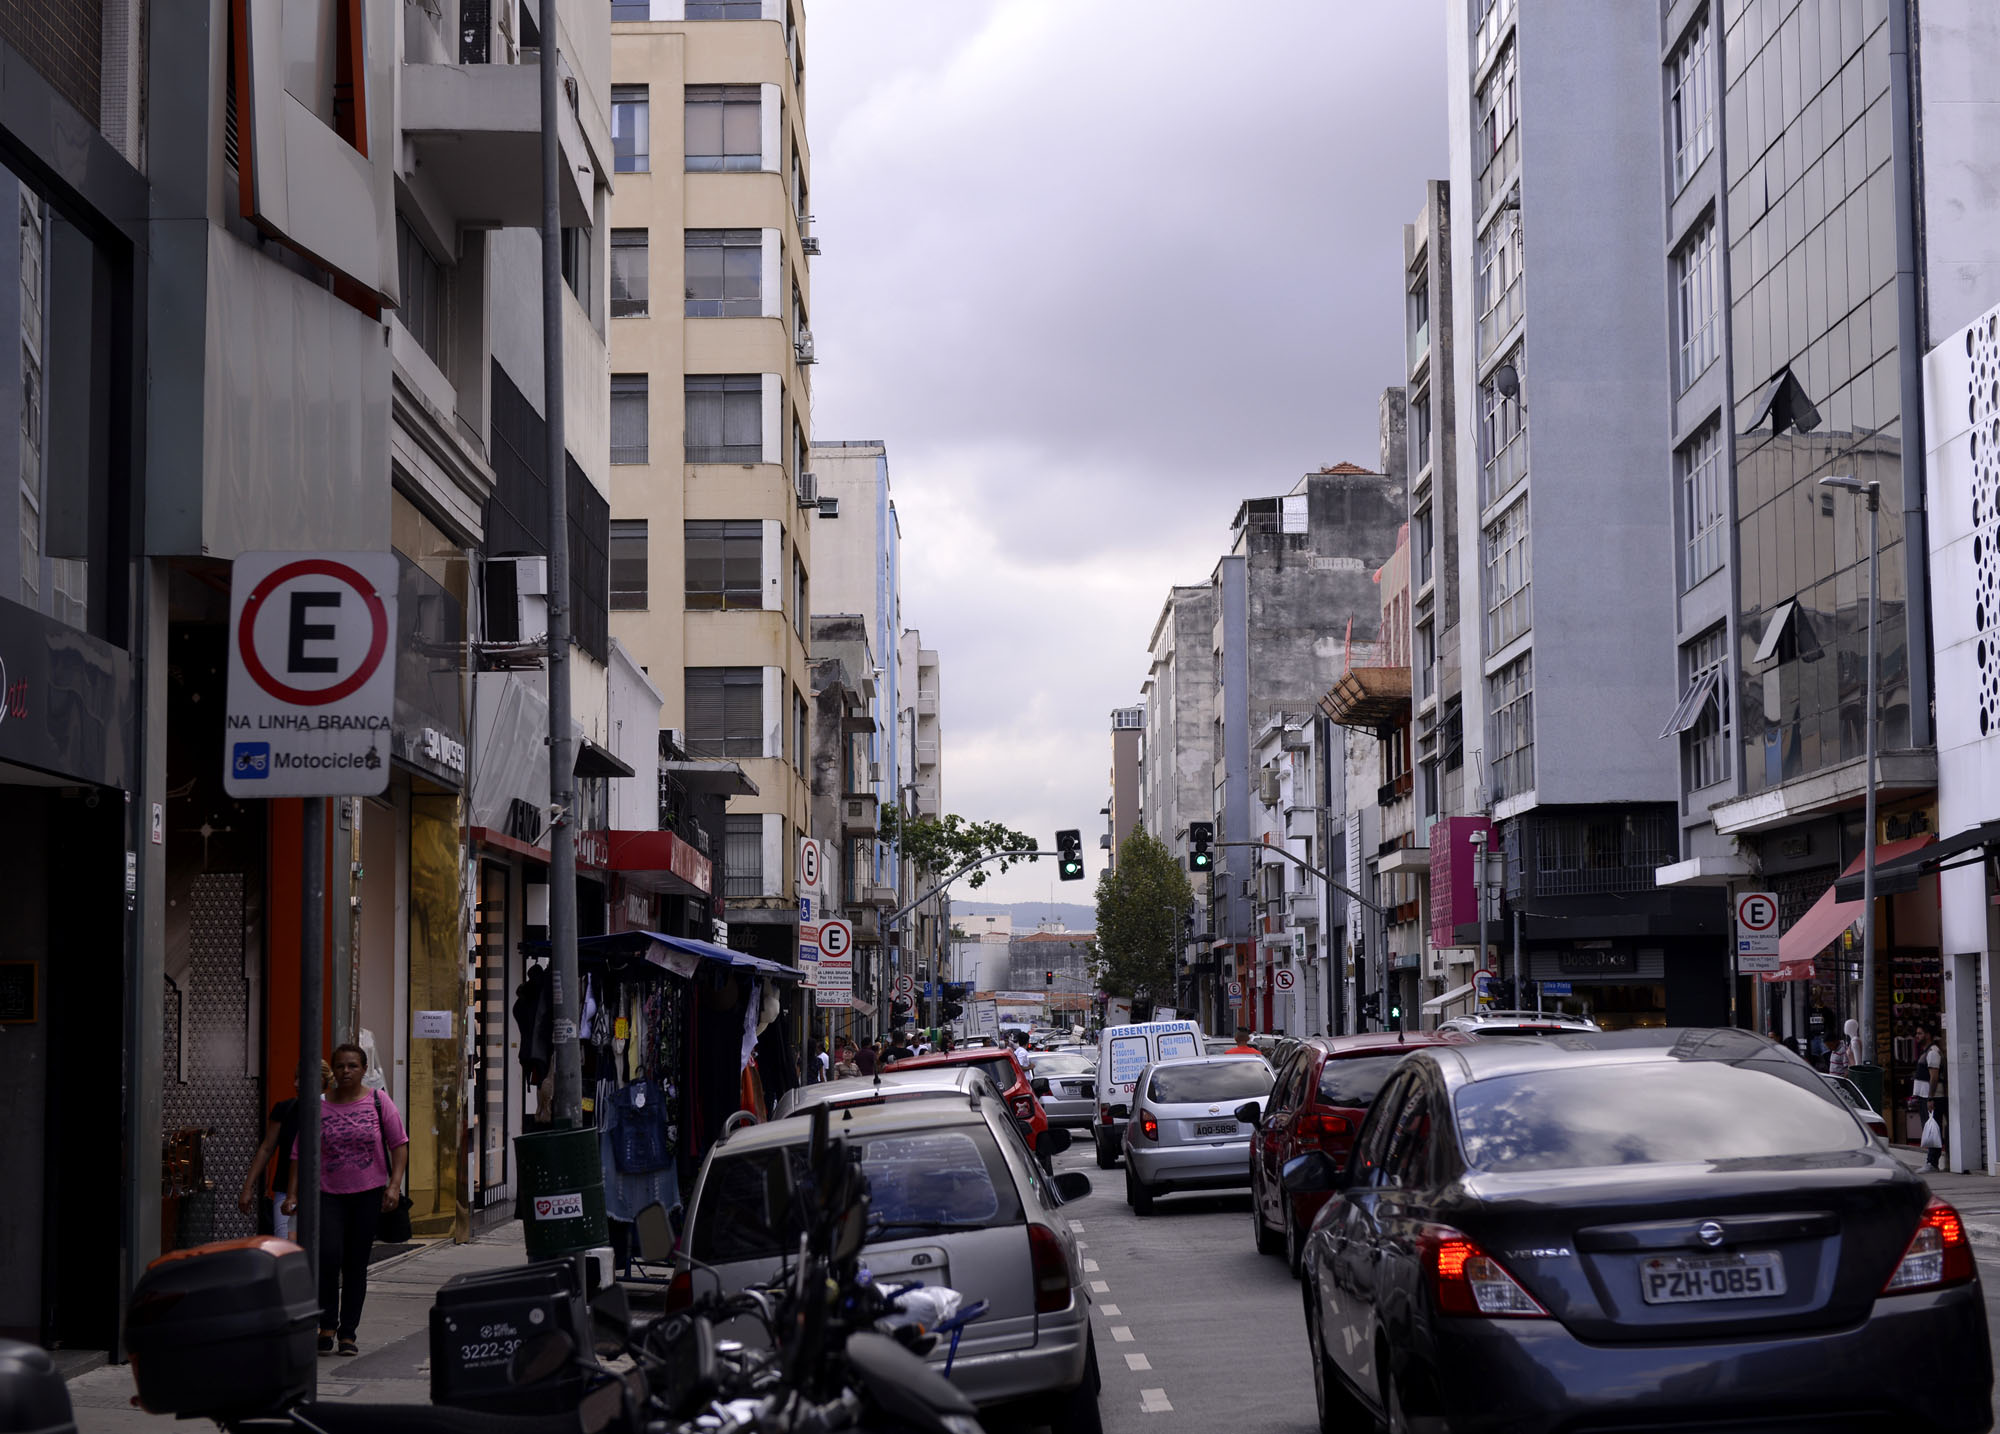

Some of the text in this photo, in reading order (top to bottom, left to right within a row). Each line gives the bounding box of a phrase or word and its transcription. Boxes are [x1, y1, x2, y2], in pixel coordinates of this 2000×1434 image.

[287, 592, 342, 673] E
[228, 714, 391, 730] NA LINHA BRANCA
[424, 728, 466, 774] SAVASSI
[807, 850, 814, 877] E
[1751, 903, 1764, 924] E
[828, 929, 841, 950] E
[1111, 1022, 1191, 1037] DESENTUPIDORA
[552, 1196, 580, 1206] CIDADE
[552, 1205, 581, 1215] LINDA
[1505, 1248, 1571, 1260] VERSA
